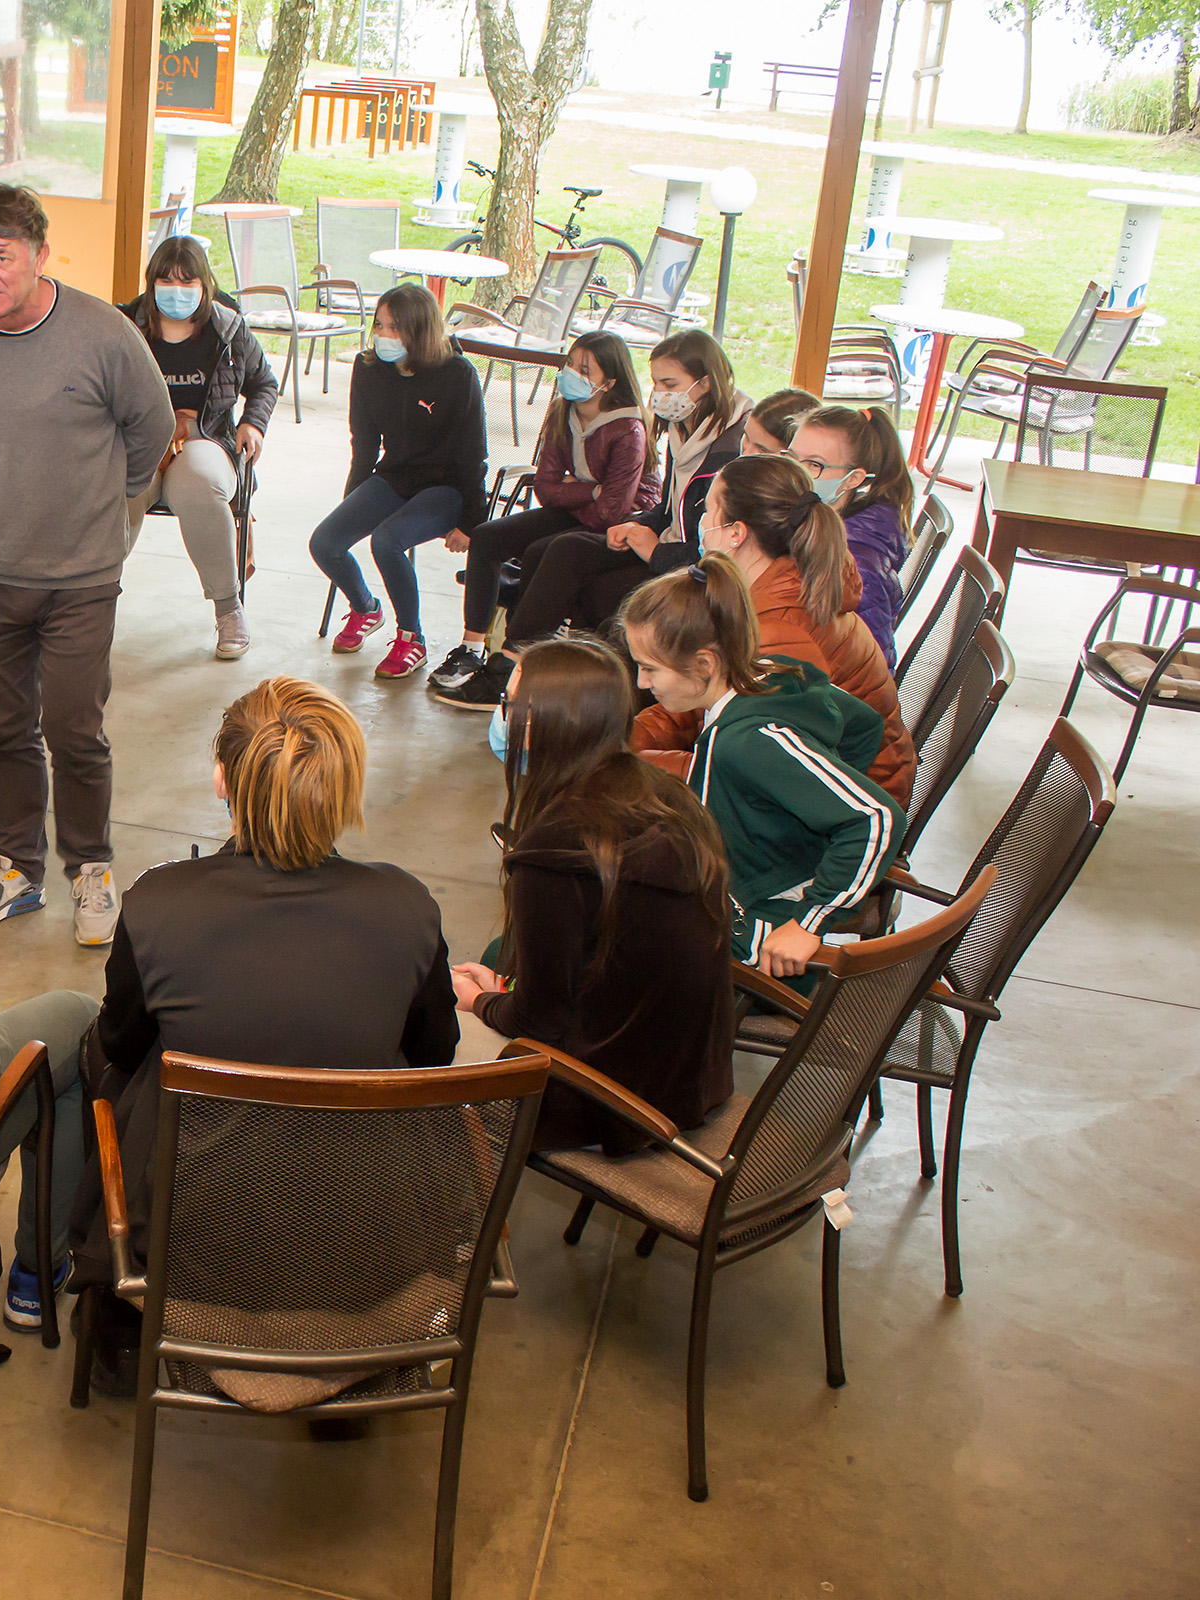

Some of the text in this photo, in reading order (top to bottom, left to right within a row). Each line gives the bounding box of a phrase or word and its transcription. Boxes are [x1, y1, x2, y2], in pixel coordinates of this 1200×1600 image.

[439, 126, 456, 183] Prelog
[877, 168, 894, 217] relog
[1112, 218, 1138, 289] Prelog
